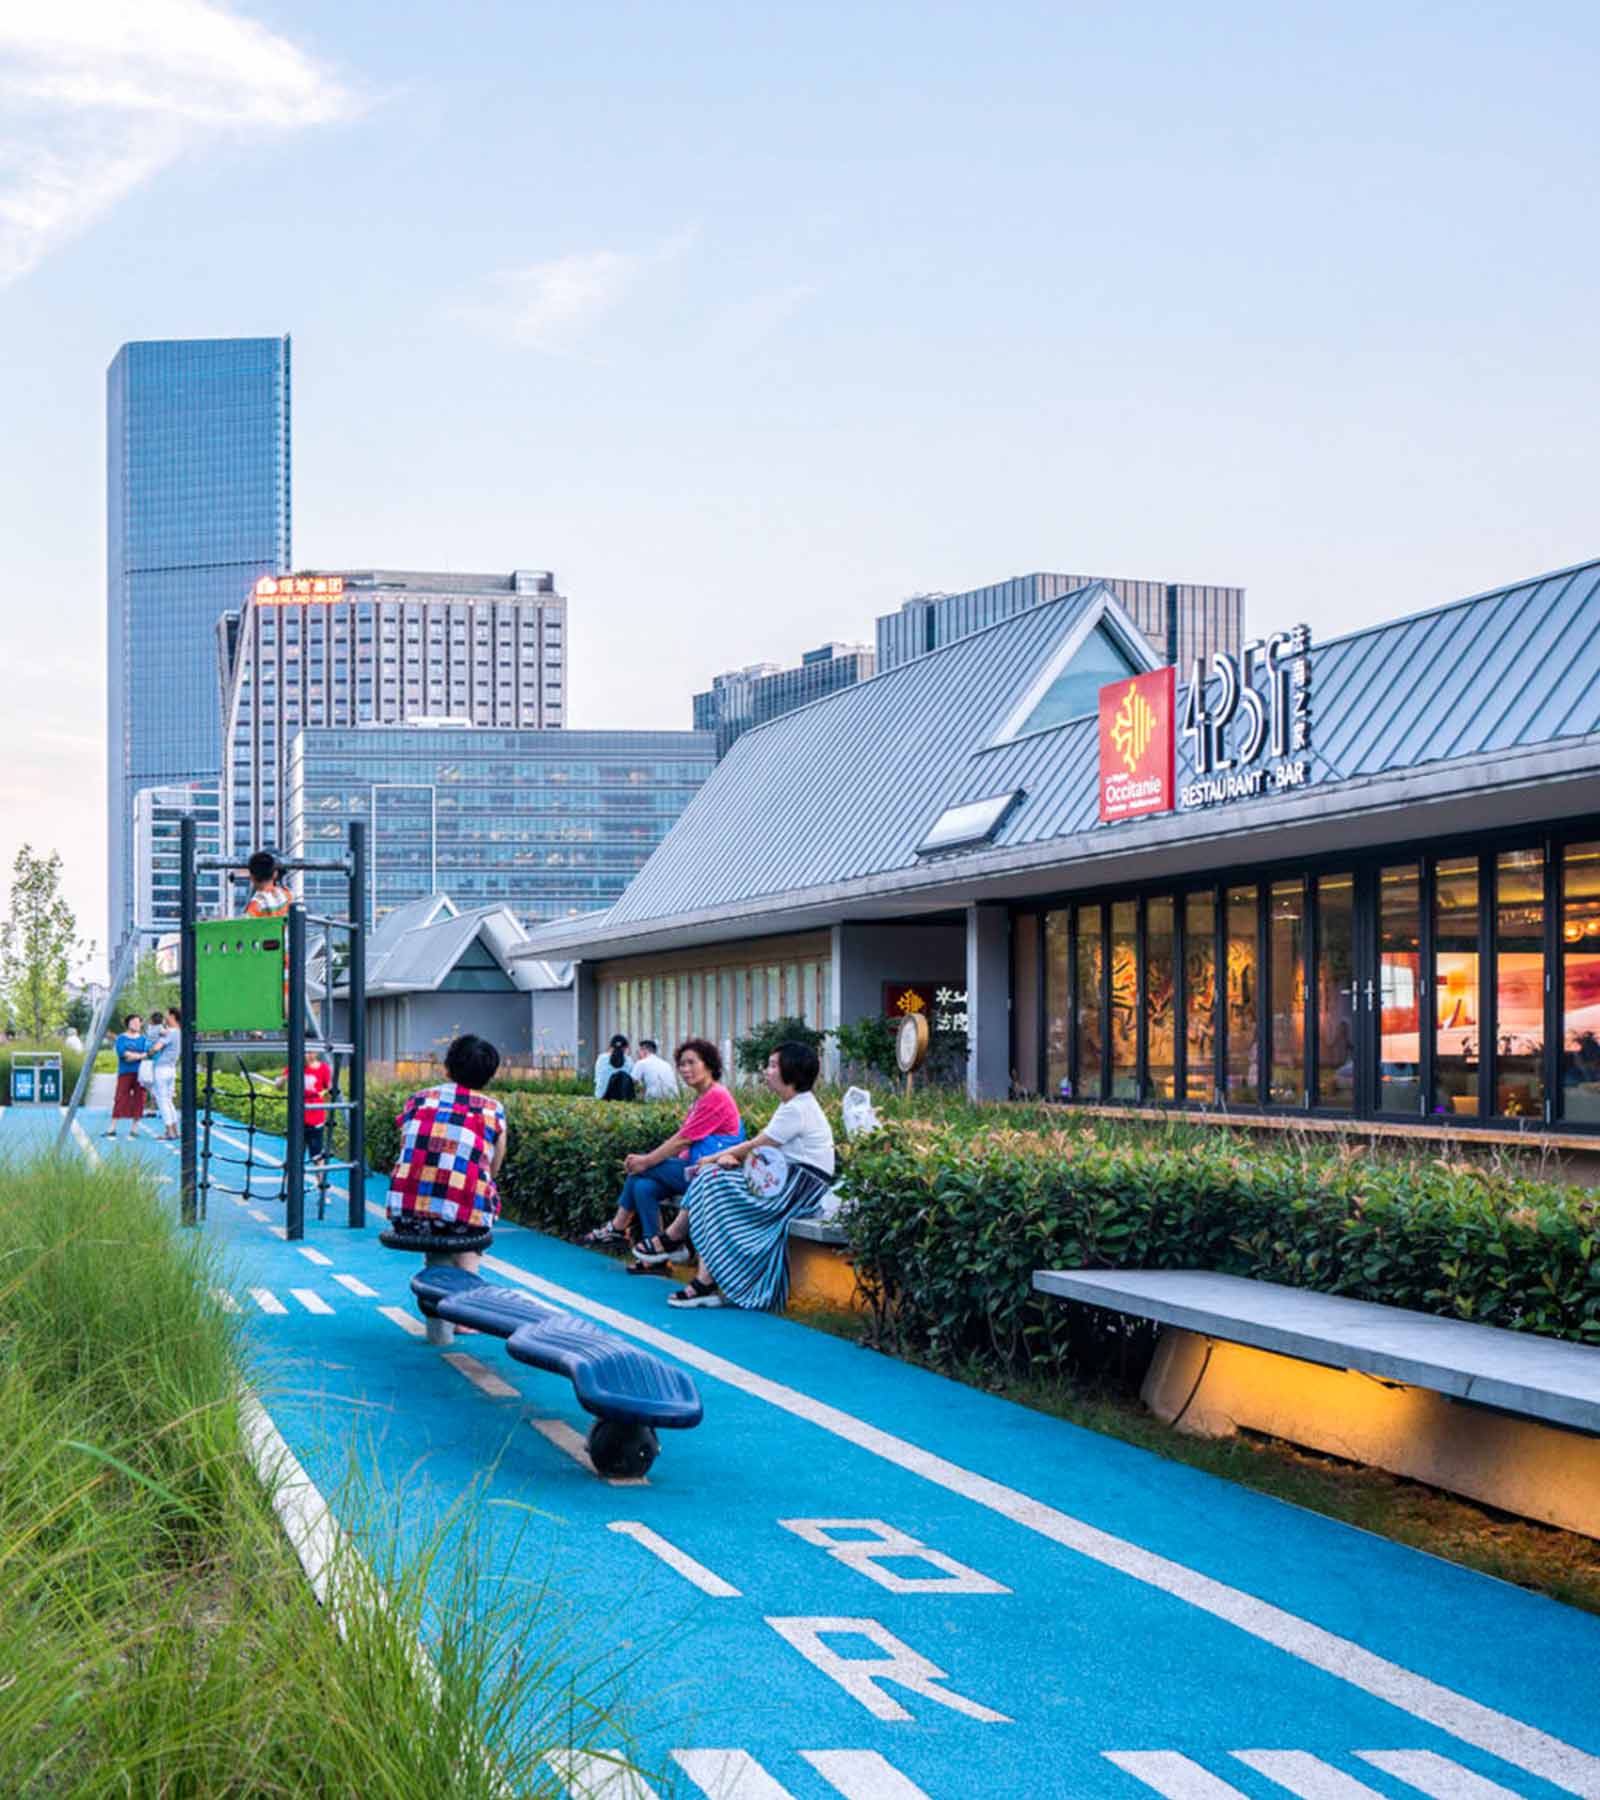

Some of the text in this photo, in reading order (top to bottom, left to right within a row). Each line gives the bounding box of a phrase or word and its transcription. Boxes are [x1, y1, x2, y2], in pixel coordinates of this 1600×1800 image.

[1105, 775, 1162, 803] Occitanie
[1180, 770, 1263, 807] RESTAURANT
[1275, 762, 1304, 788] BAR
[763, 1616, 1015, 1723] R
